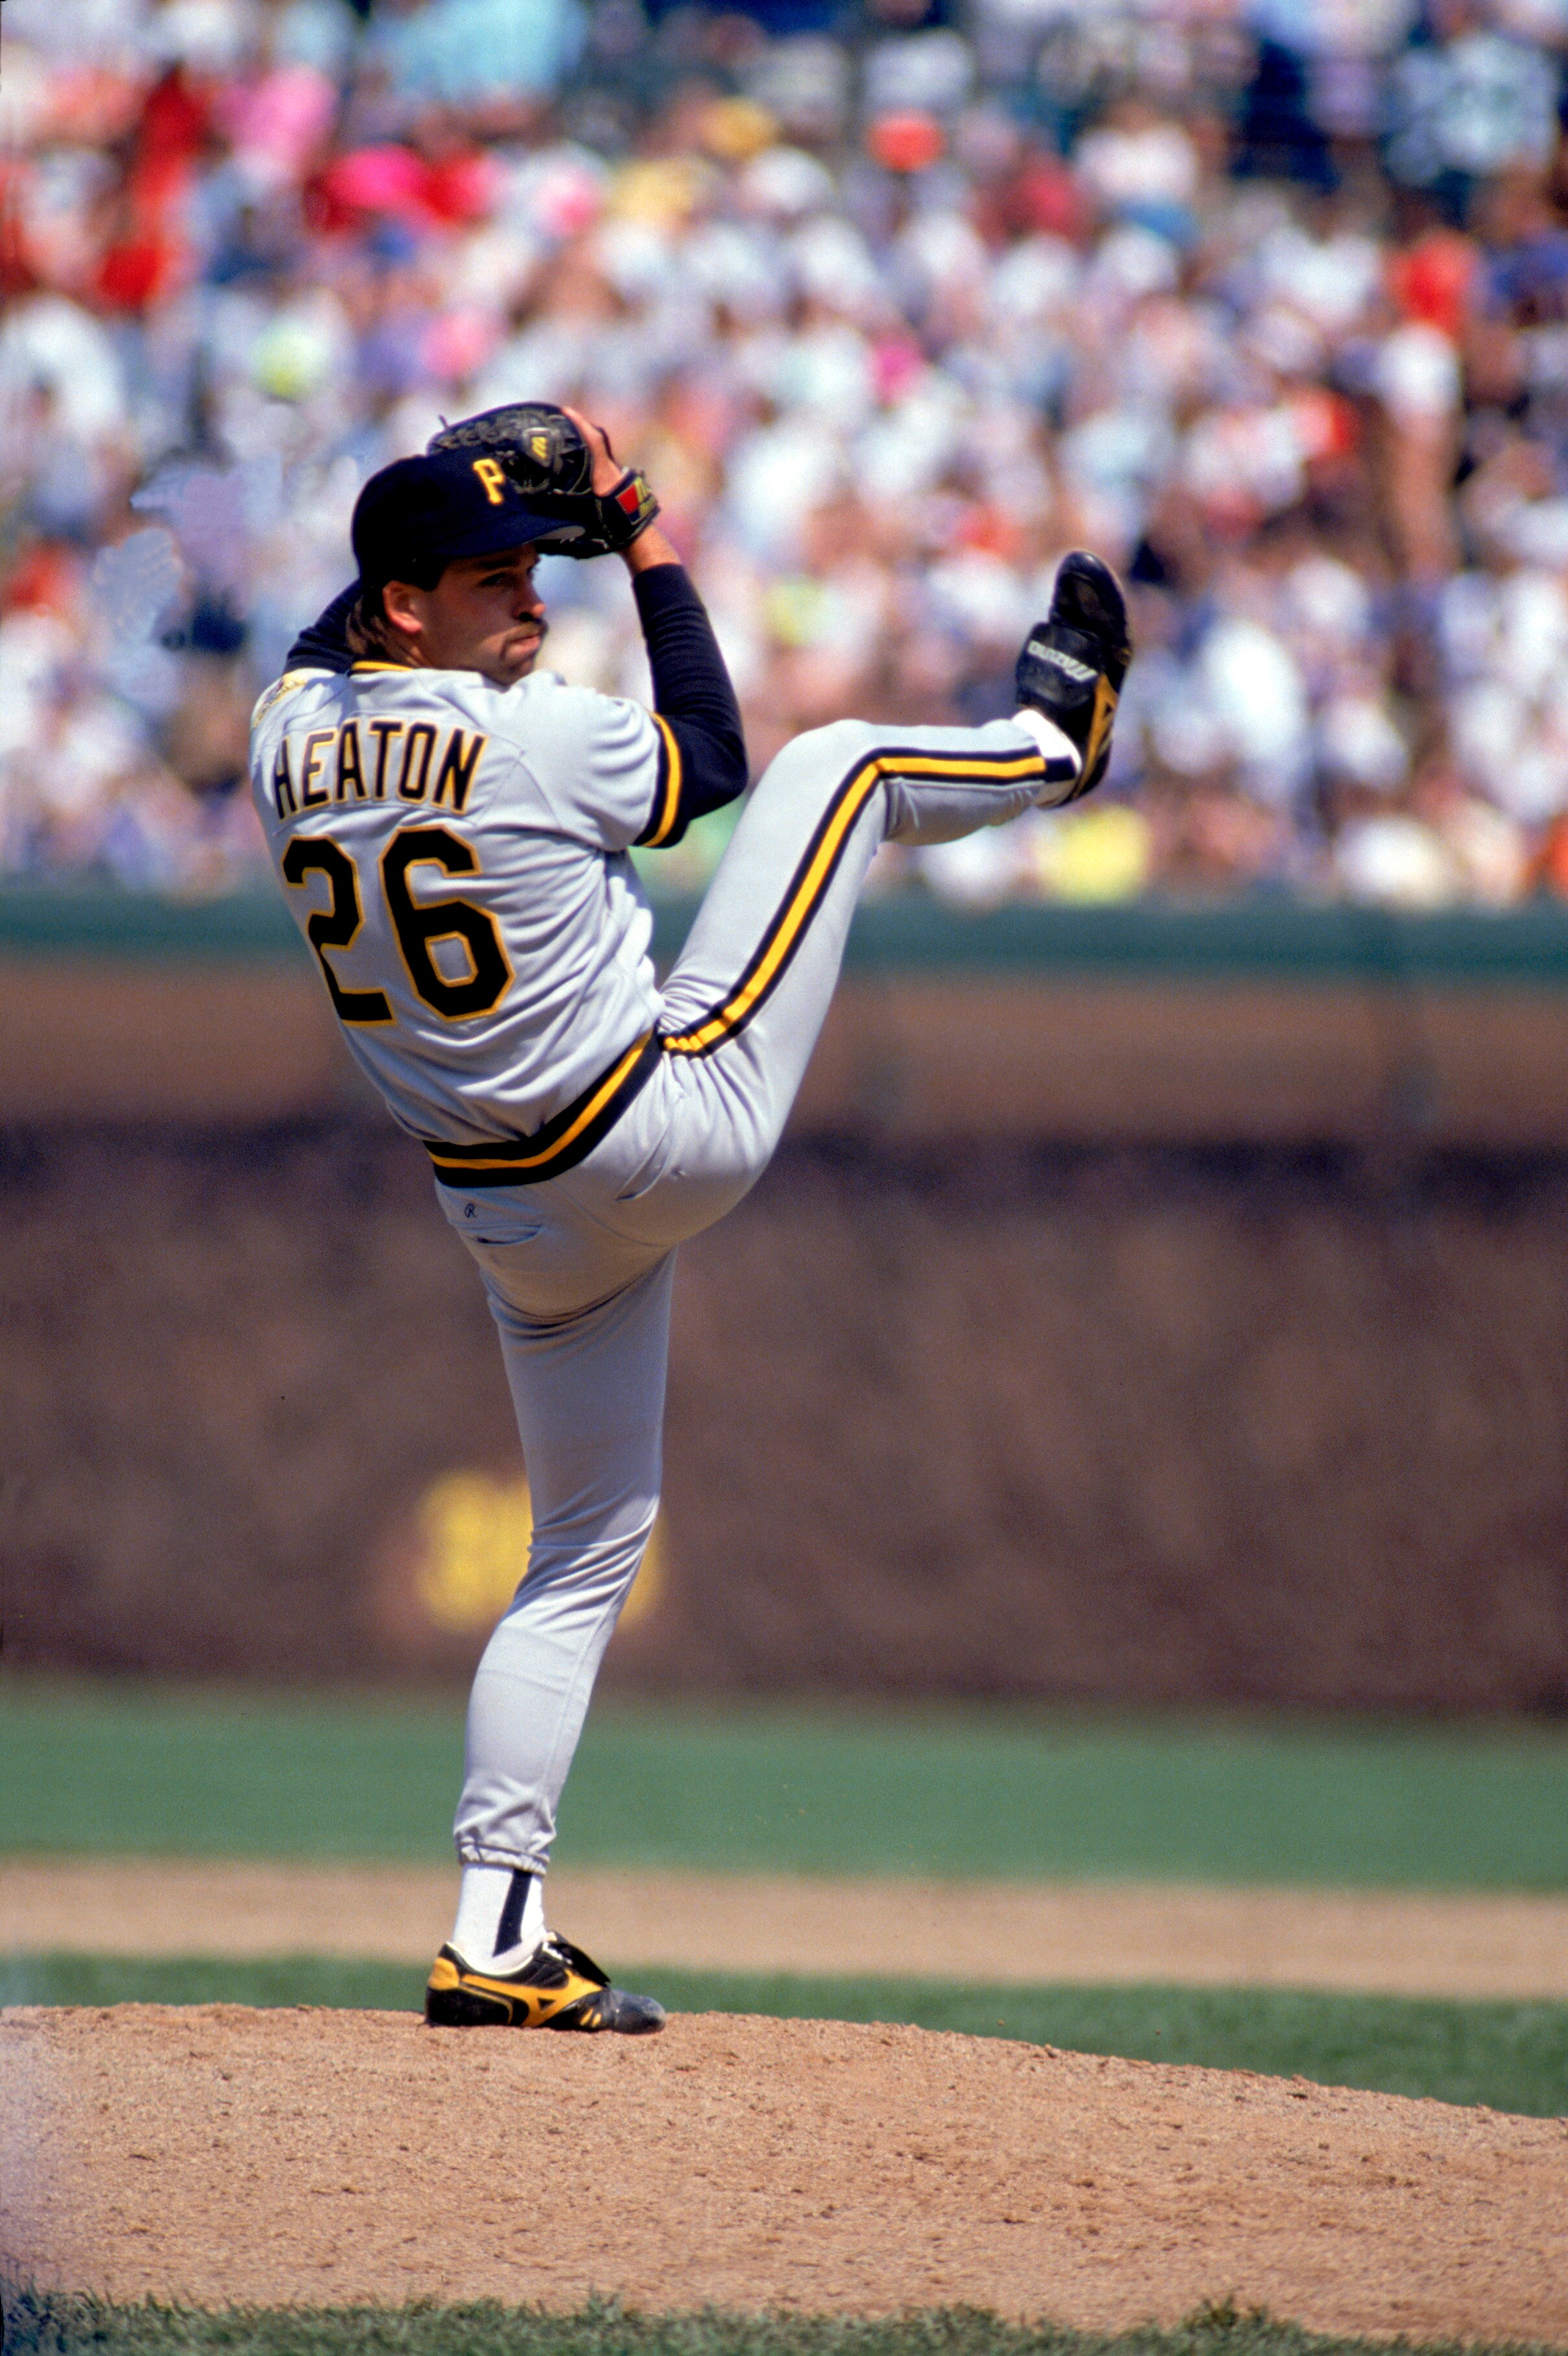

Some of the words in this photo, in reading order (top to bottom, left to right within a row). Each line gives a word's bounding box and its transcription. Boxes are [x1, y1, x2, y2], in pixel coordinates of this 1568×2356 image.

[472, 458, 505, 506] P
[273, 717, 490, 823] HEATON
[281, 824, 517, 1027] 26
